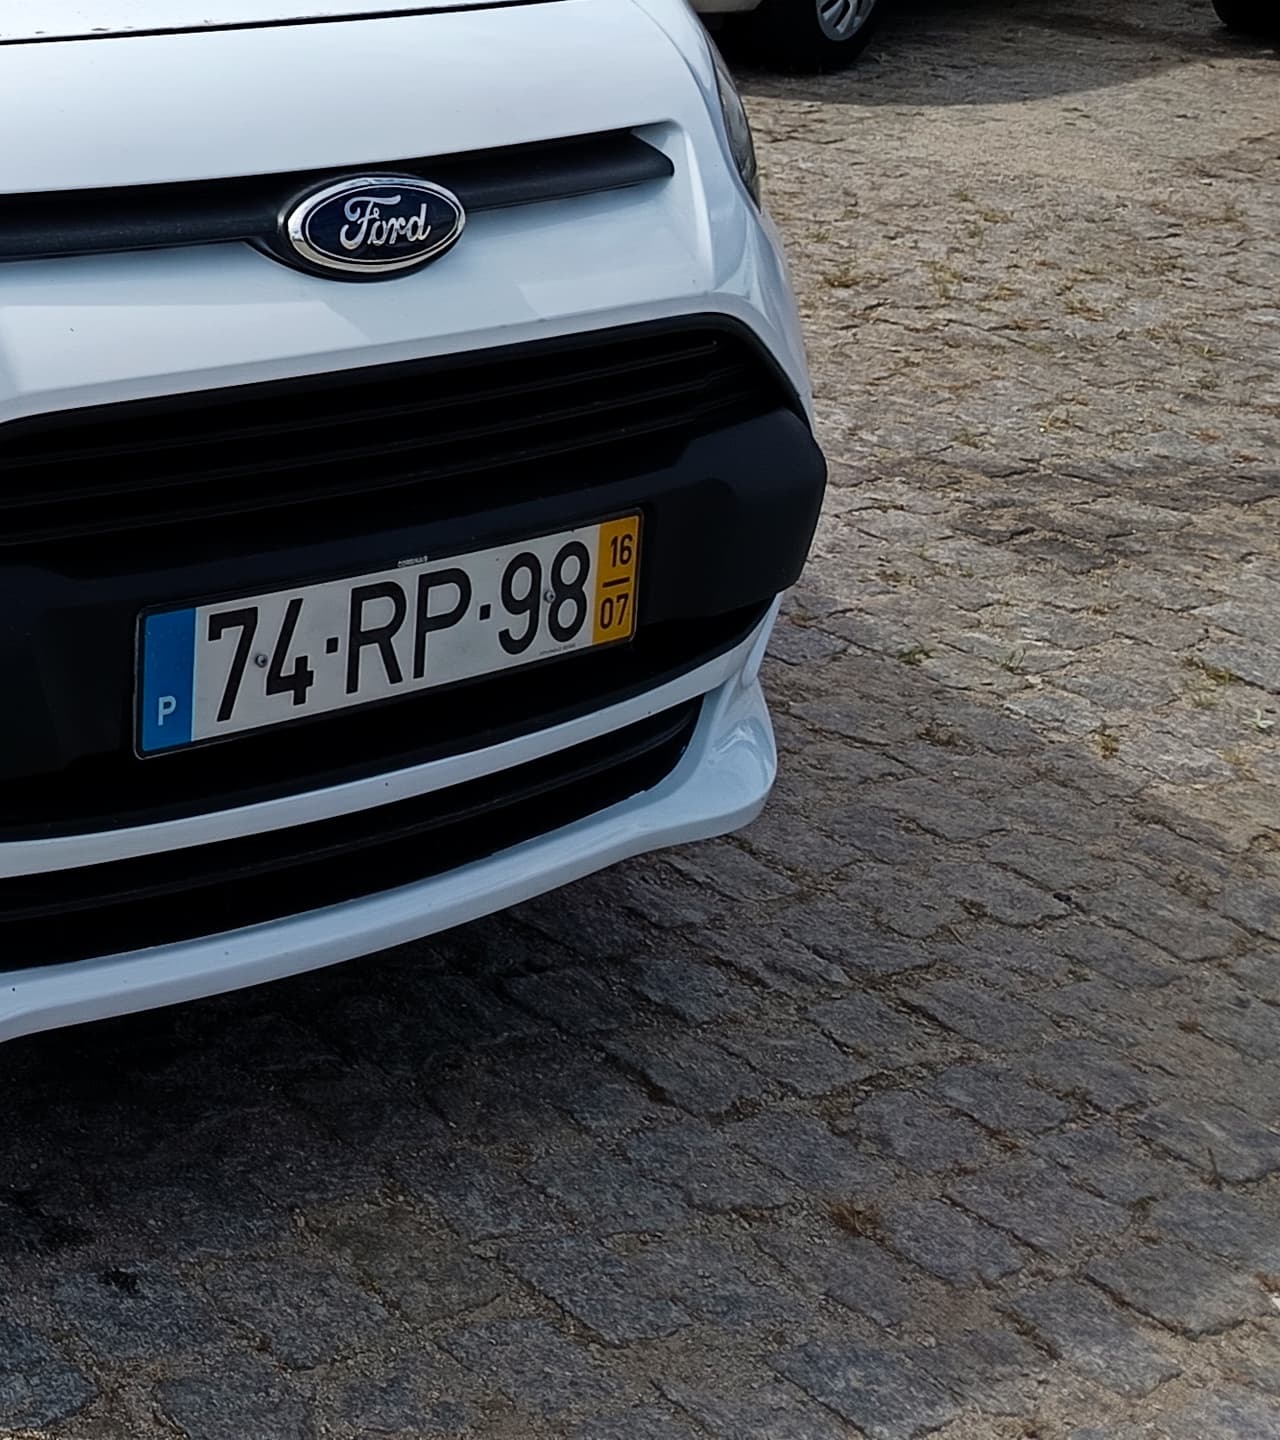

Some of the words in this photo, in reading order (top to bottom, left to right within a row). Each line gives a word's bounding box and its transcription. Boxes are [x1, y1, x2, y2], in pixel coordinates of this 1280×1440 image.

[340, 194, 431, 250] Ford
[610, 533, 634, 569] 16
[599, 595, 629, 630] 07
[157, 695, 177, 726] P
